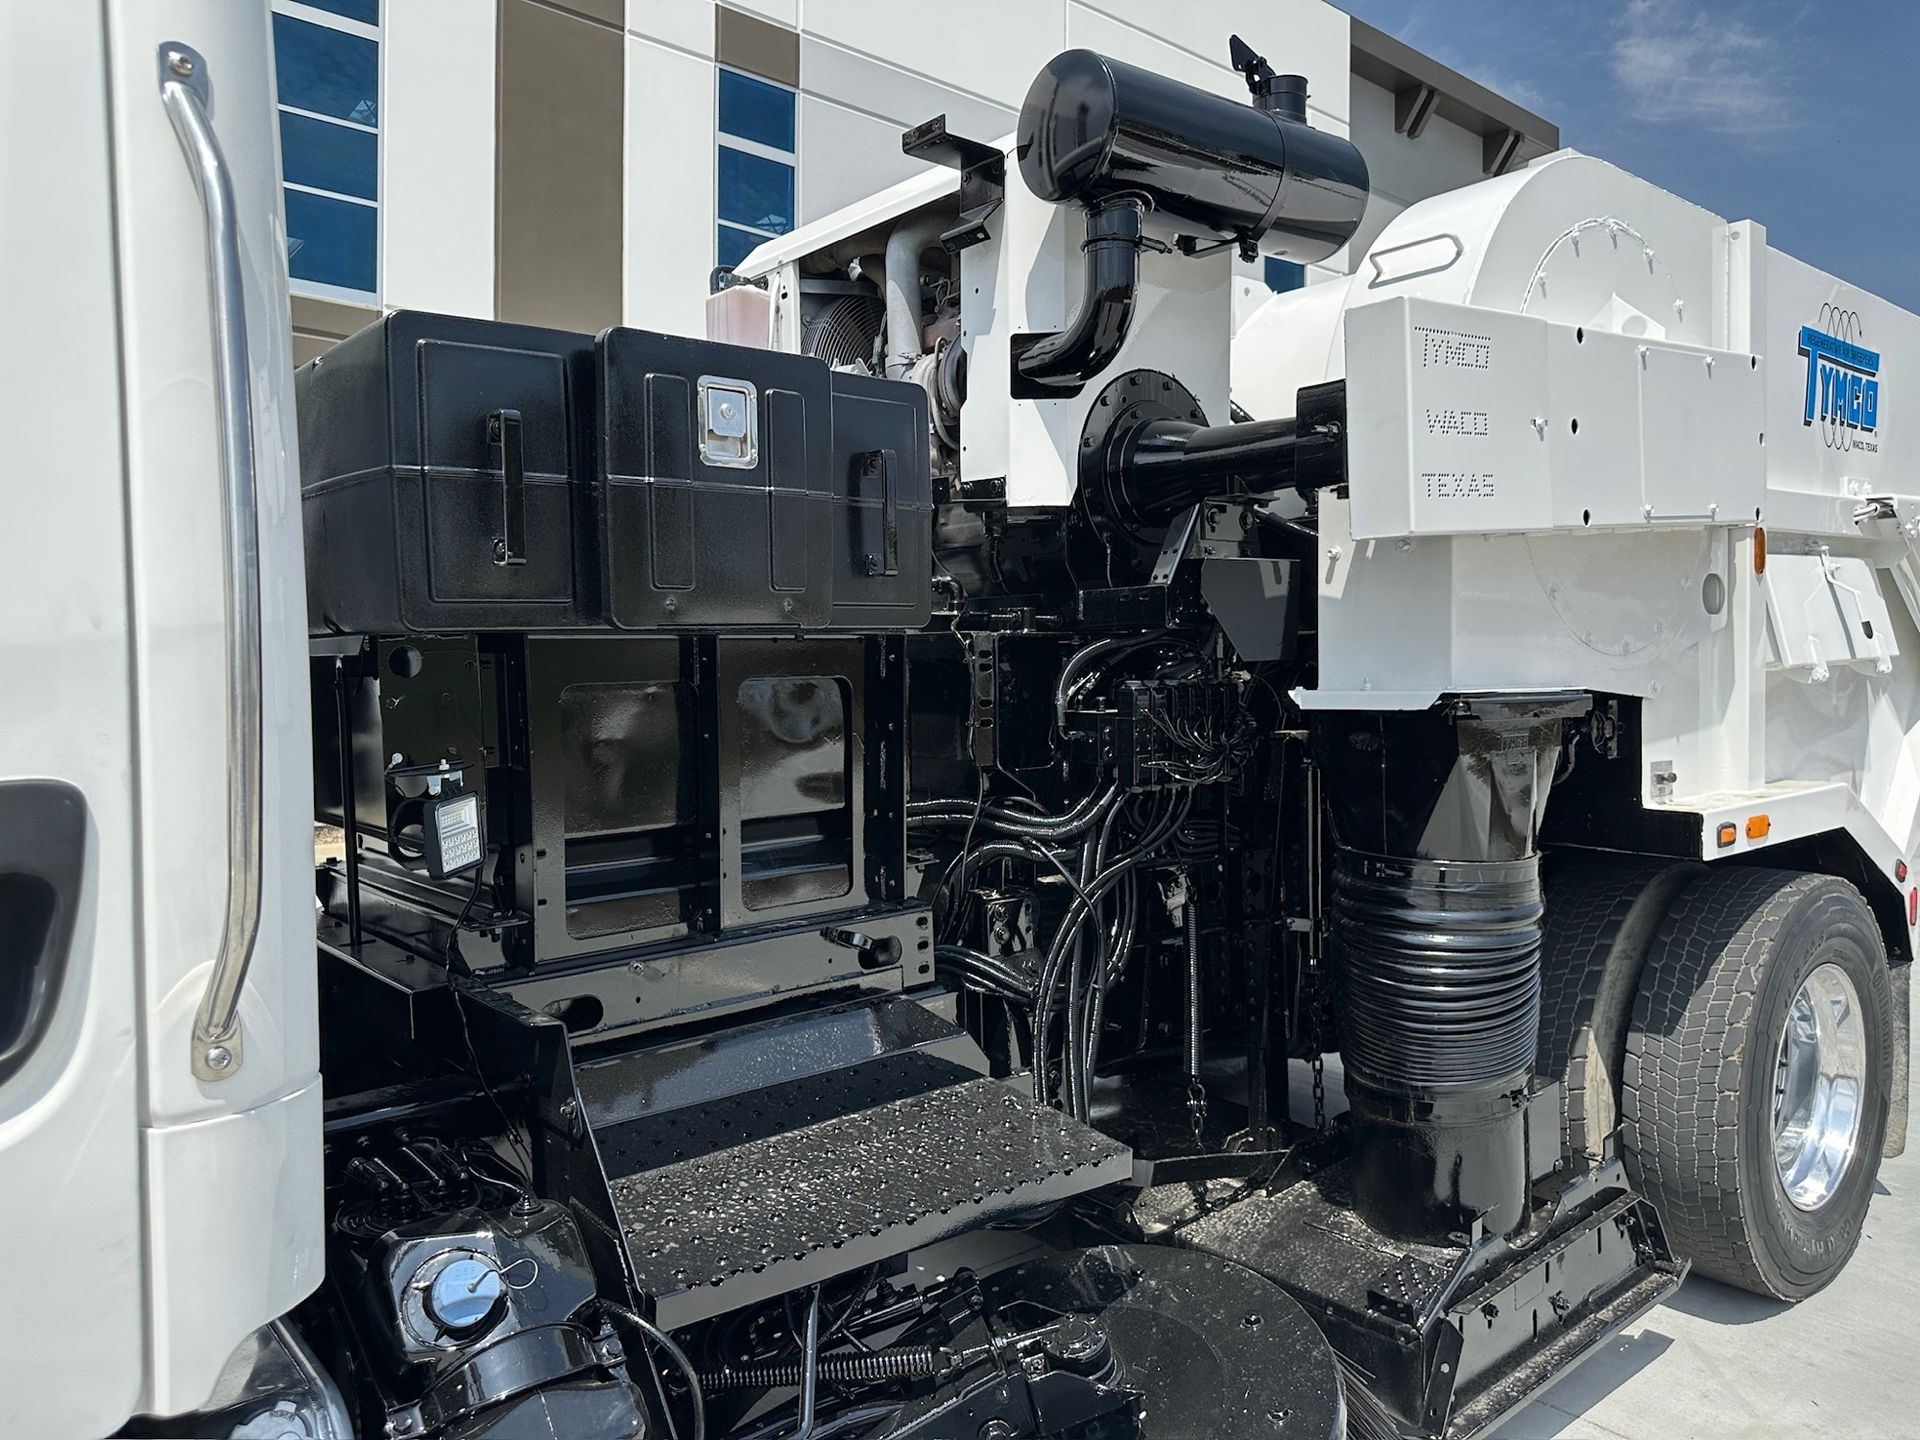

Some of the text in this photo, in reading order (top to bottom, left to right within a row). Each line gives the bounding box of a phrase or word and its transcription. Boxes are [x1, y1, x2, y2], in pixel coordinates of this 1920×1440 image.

[1414, 326, 1491, 370] TYMCO
[1798, 325, 1880, 433] TYMCO
[1426, 409, 1488, 436] WACO
[1422, 474, 1494, 498] TEXAS
